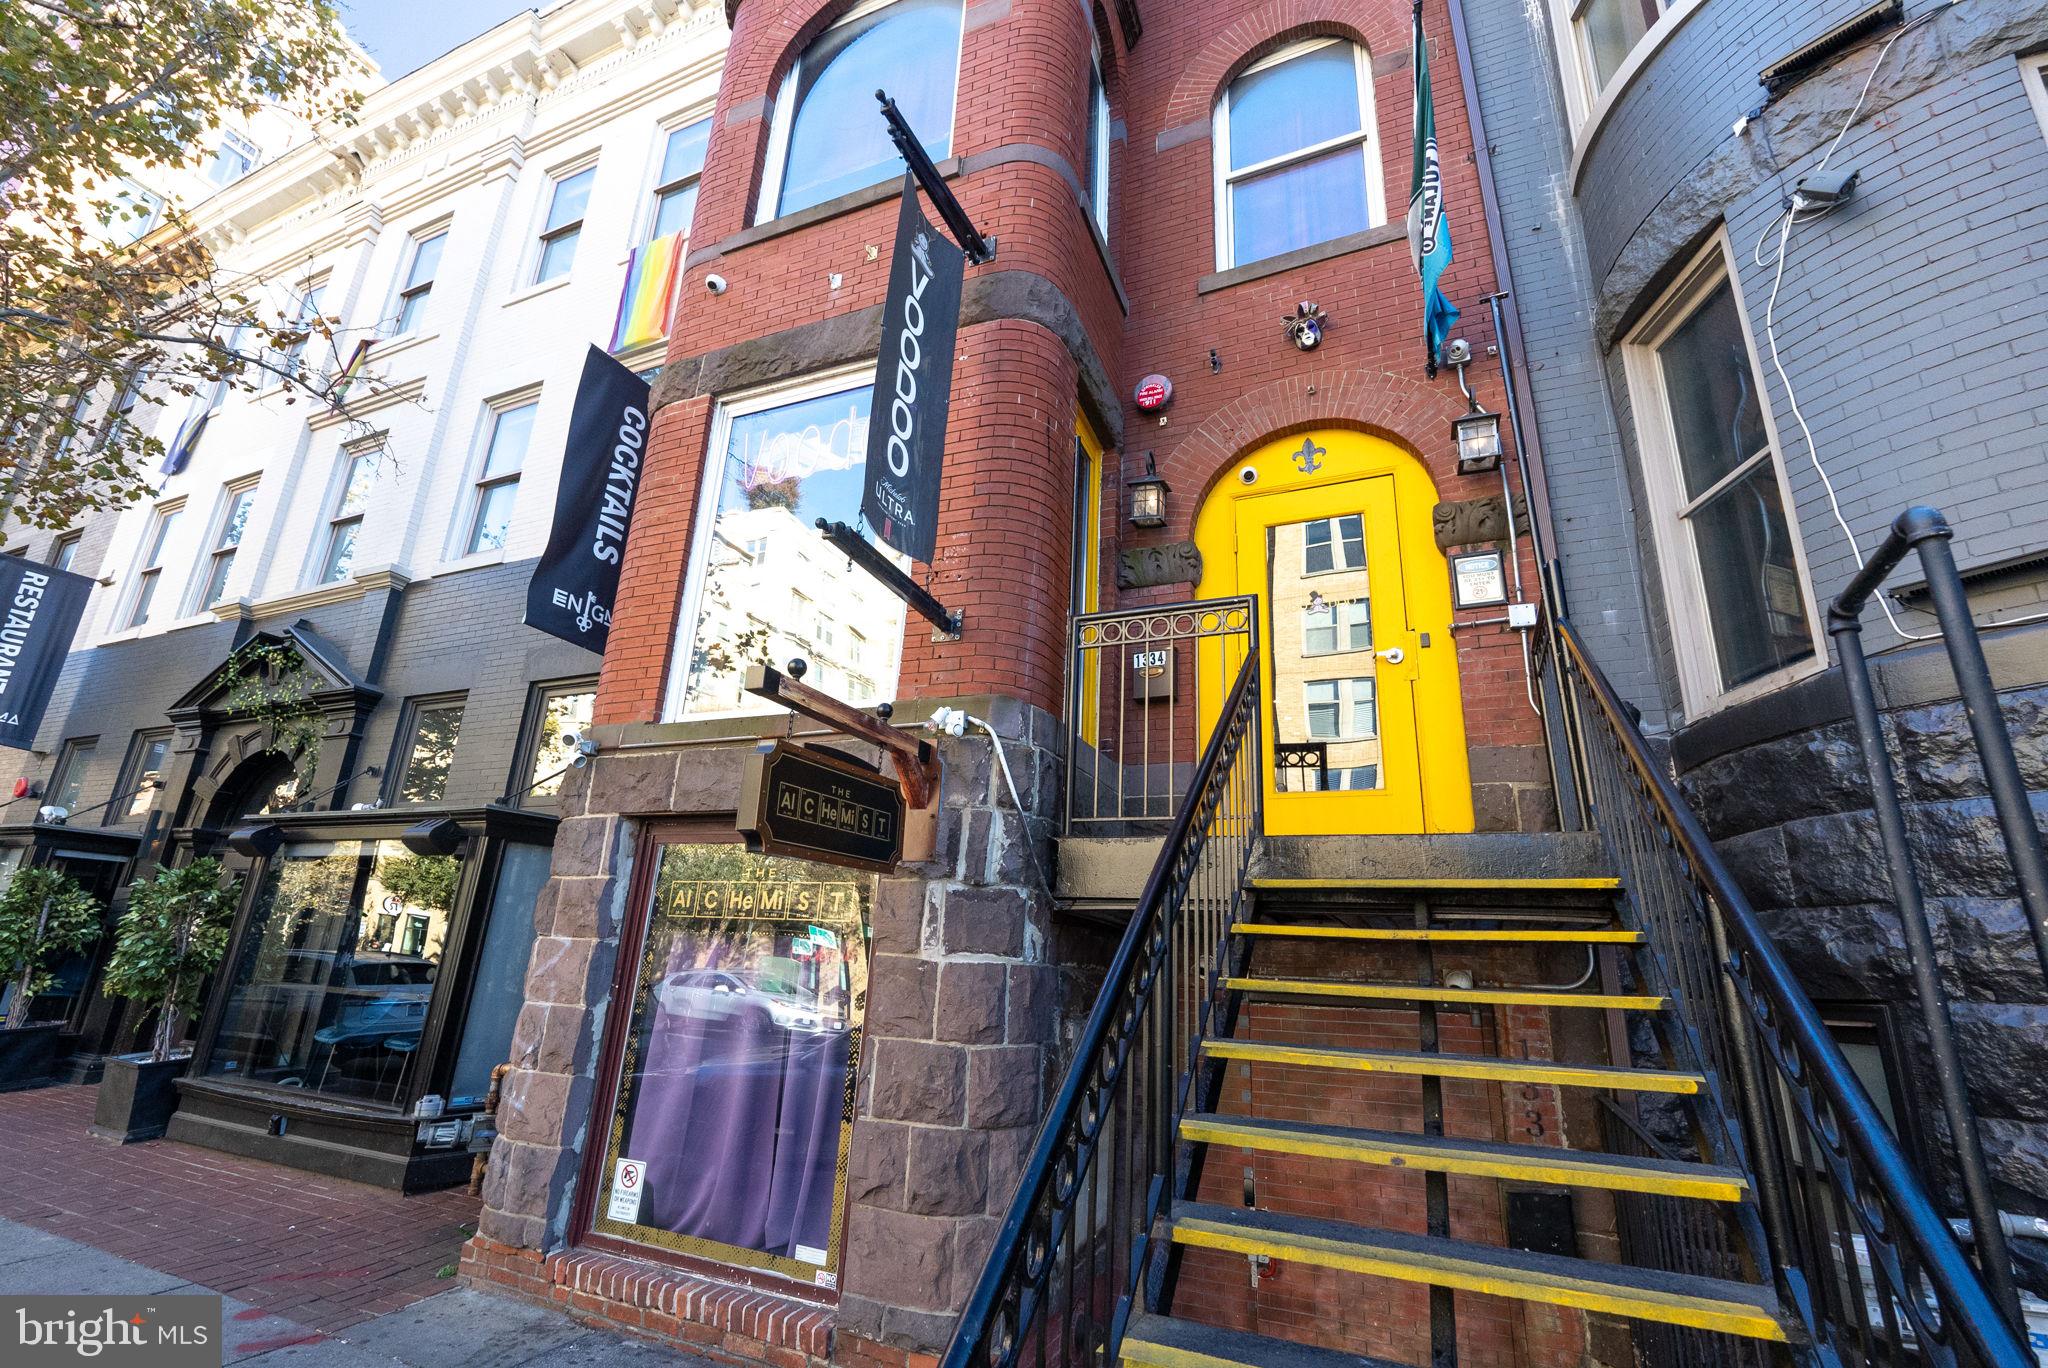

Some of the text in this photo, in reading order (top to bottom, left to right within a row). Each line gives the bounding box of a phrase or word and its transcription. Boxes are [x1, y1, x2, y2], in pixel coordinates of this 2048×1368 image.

[887, 255, 930, 478] VOODOO
[592, 406, 646, 565] COCKTAILS
[876, 481, 914, 525] ULTRA
[1135, 652, 1164, 668] 1334
[831, 786, 851, 798] THE
[744, 867, 776, 878] THE
